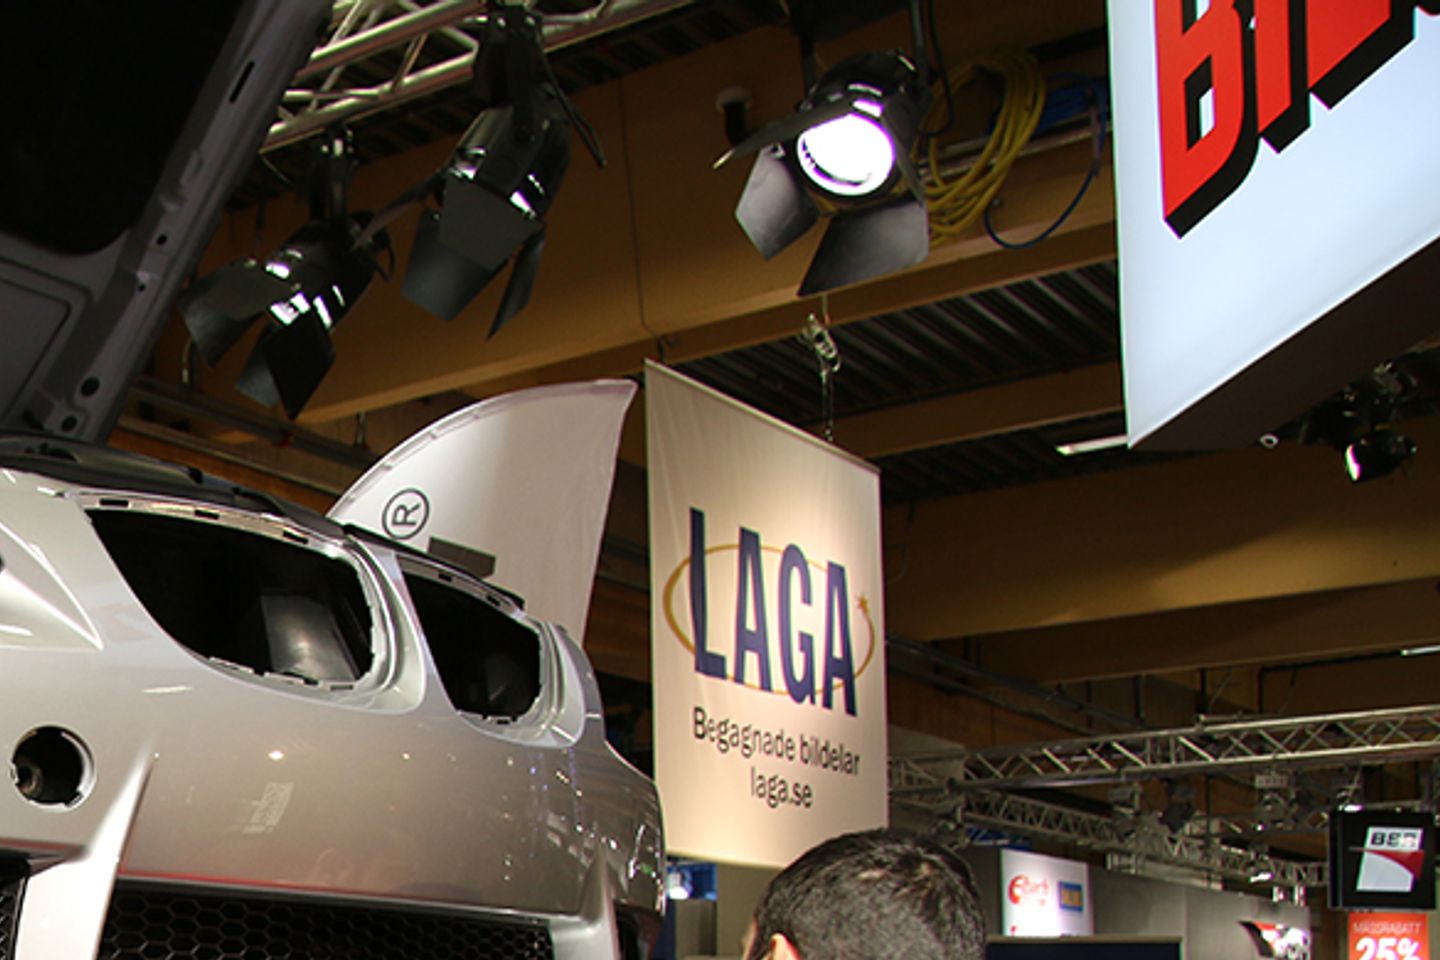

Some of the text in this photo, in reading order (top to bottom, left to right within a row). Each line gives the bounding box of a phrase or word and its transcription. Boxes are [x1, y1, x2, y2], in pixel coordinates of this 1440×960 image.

[689, 507, 858, 717] LAGA
[693, 707, 861, 776] Begagnade bildelar
[750, 766, 814, 809] laga.se
